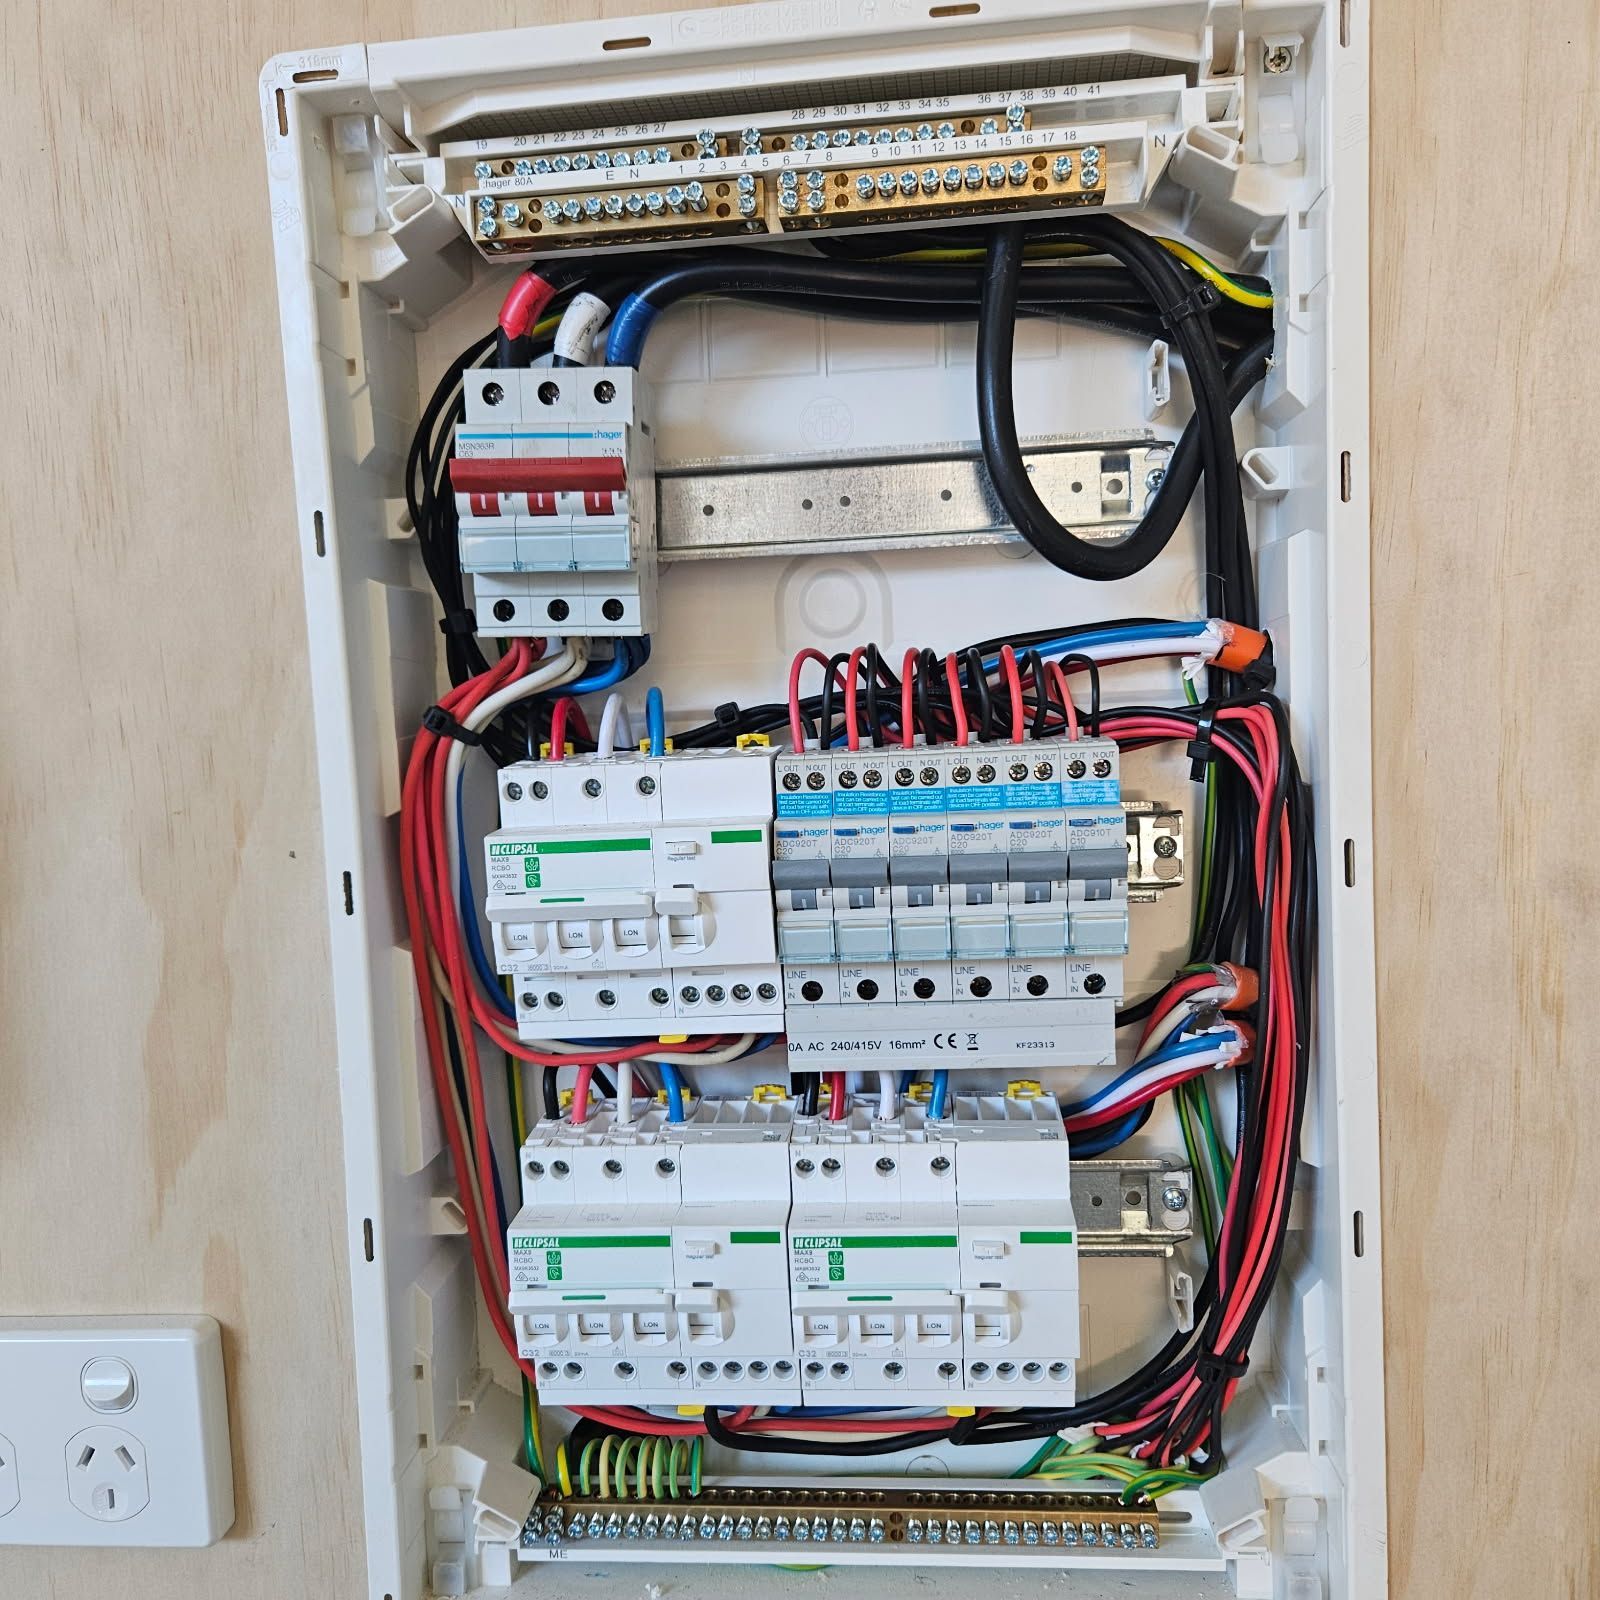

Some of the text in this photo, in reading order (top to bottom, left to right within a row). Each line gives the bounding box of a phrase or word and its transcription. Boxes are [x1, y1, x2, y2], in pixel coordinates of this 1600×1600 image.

[476, 85, 1101, 150] 19 20 21 22 23 24 25 26 27 28 29 30 31 32 33 34 35 36 37 38 39 40 41
[1154, 135, 1166, 147] N
[514, 177, 533, 186] 80A
[606, 171, 615, 180] E
[630, 169, 639, 178] N
[679, 165, 683, 174] 1
[699, 163, 705, 173] 2
[720, 161, 726, 170] 3
[741, 159, 747, 168] 4
[762, 158, 768, 166] 5
[784, 156, 790, 164] 6
[805, 154, 811, 163] 7
[826, 152, 832, 161] 8
[872, 148, 878, 158] 9
[888, 146, 900, 156] 10
[912, 144, 922, 154] 11
[933, 142, 945, 152] 12
[954, 141, 966, 150] 13
[976, 139, 987, 148] 14
[1000, 136, 1012, 146] 15
[1021, 134, 1033, 144] 16
[1042, 132, 1055, 142] 17
[1065, 131, 1076, 141] 18
[455, 196, 466, 208] N
[899, 968, 918, 976] LINE
[954, 967, 975, 975] LINE
[1012, 964, 1032, 973] LINE
[1070, 964, 1091, 972] LINE
[842, 970, 862, 978] LINE
[808, 1042, 824, 1051] AC
[831, 1040, 882, 1051] 240/415V
[549, 1550, 568, 1559] ME
